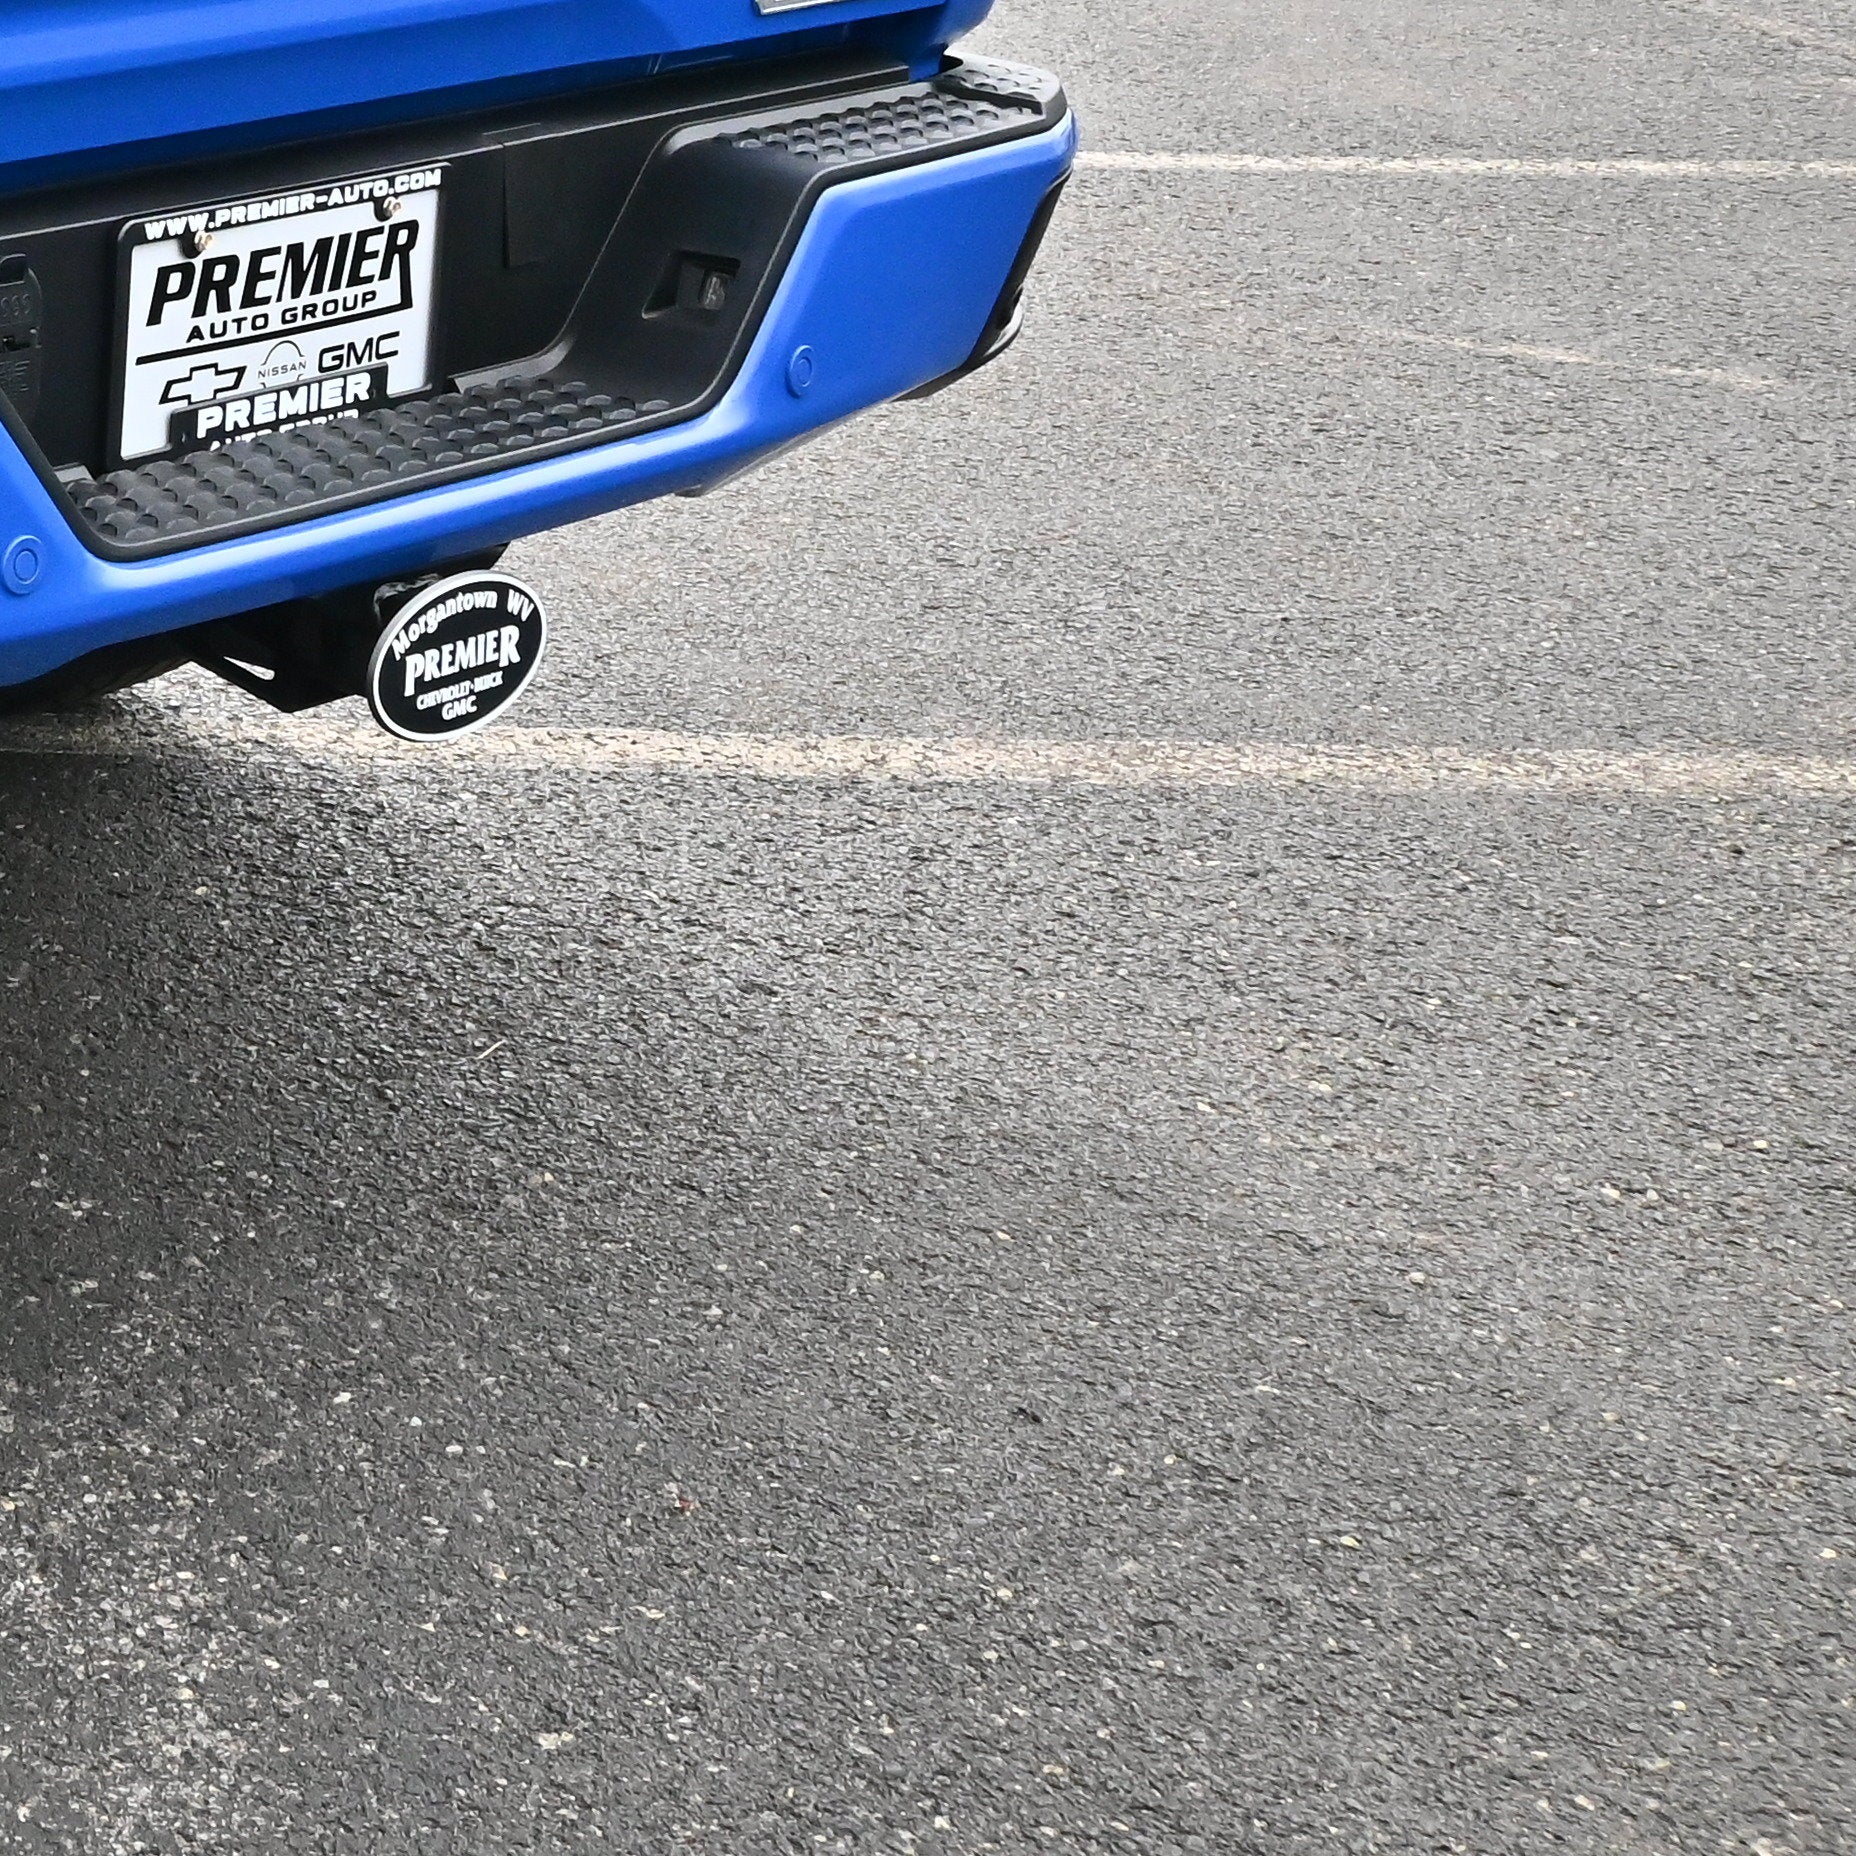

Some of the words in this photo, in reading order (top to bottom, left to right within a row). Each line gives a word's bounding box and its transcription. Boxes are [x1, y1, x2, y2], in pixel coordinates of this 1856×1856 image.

[143, 168, 442, 241] WWW.PREMIER-AUTO.COM
[145, 219, 420, 327] PREMIER
[186, 312, 270, 343] AUTO
[281, 290, 377, 326] GROUP
[257, 359, 307, 379] NISSAN
[318, 331, 400, 374] GMC
[196, 371, 372, 440] PREMIER
[391, 590, 498, 661] Morgantown
[506, 589, 535, 622] WV
[404, 624, 521, 697] PREMIER
[441, 695, 478, 721] GMC
